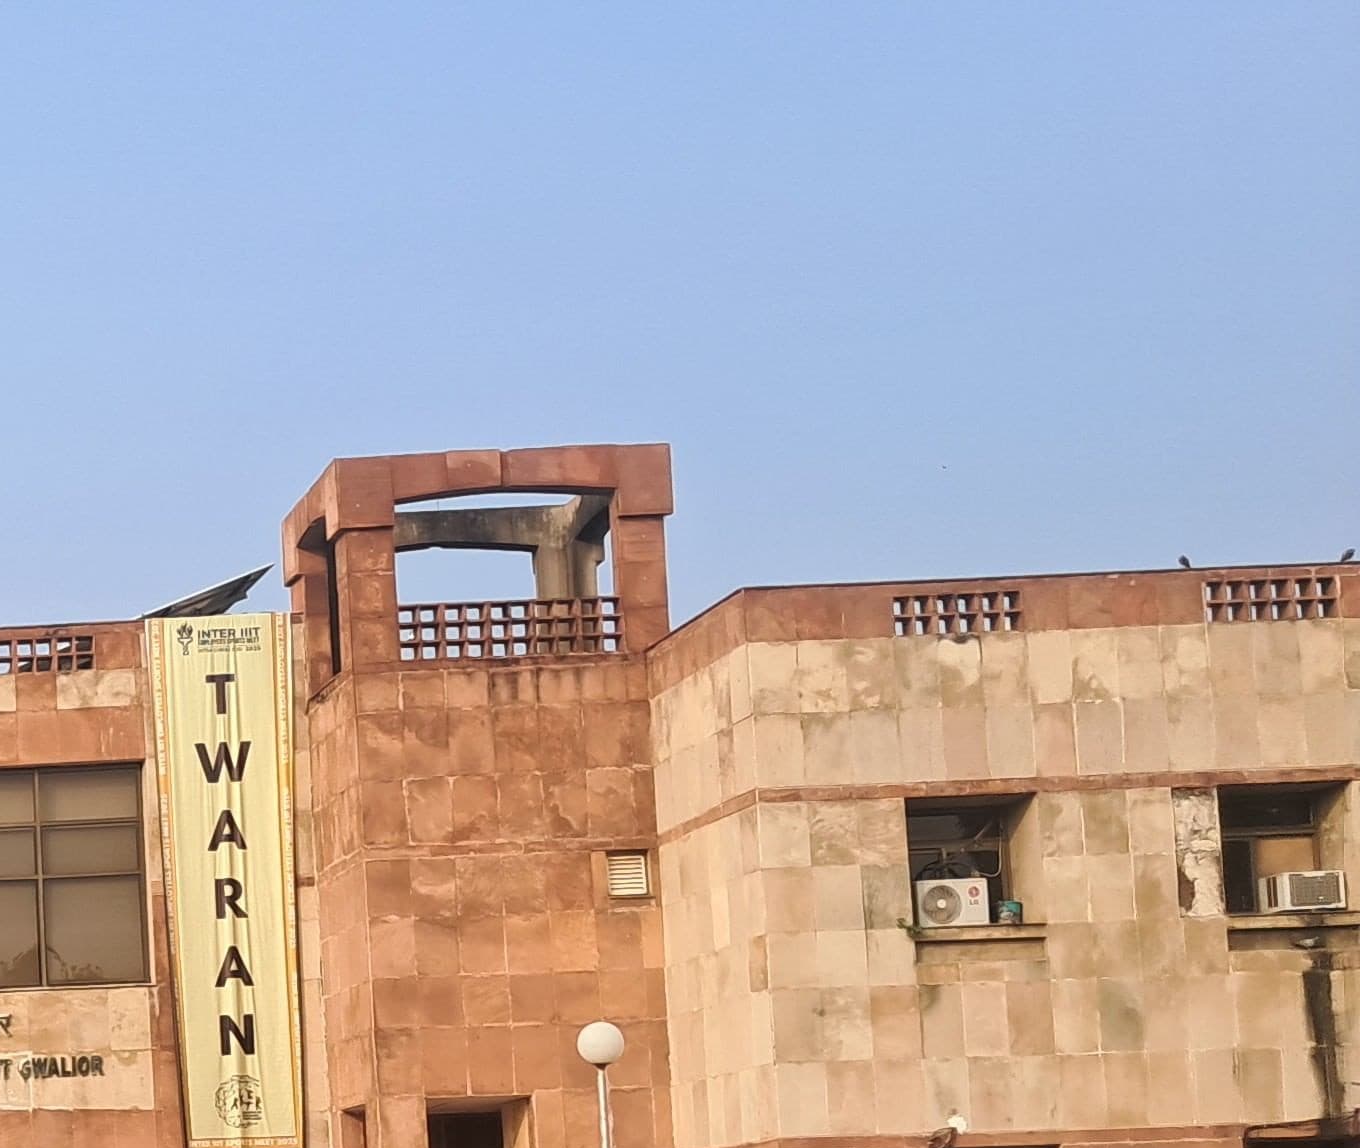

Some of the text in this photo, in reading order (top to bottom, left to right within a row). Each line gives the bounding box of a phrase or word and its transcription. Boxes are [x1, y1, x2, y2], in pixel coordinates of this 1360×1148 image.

[197, 626, 261, 639] INTER IIIT
[193, 673, 256, 1057] TWARAN
[18, 1055, 106, 1080] GWALIOR
